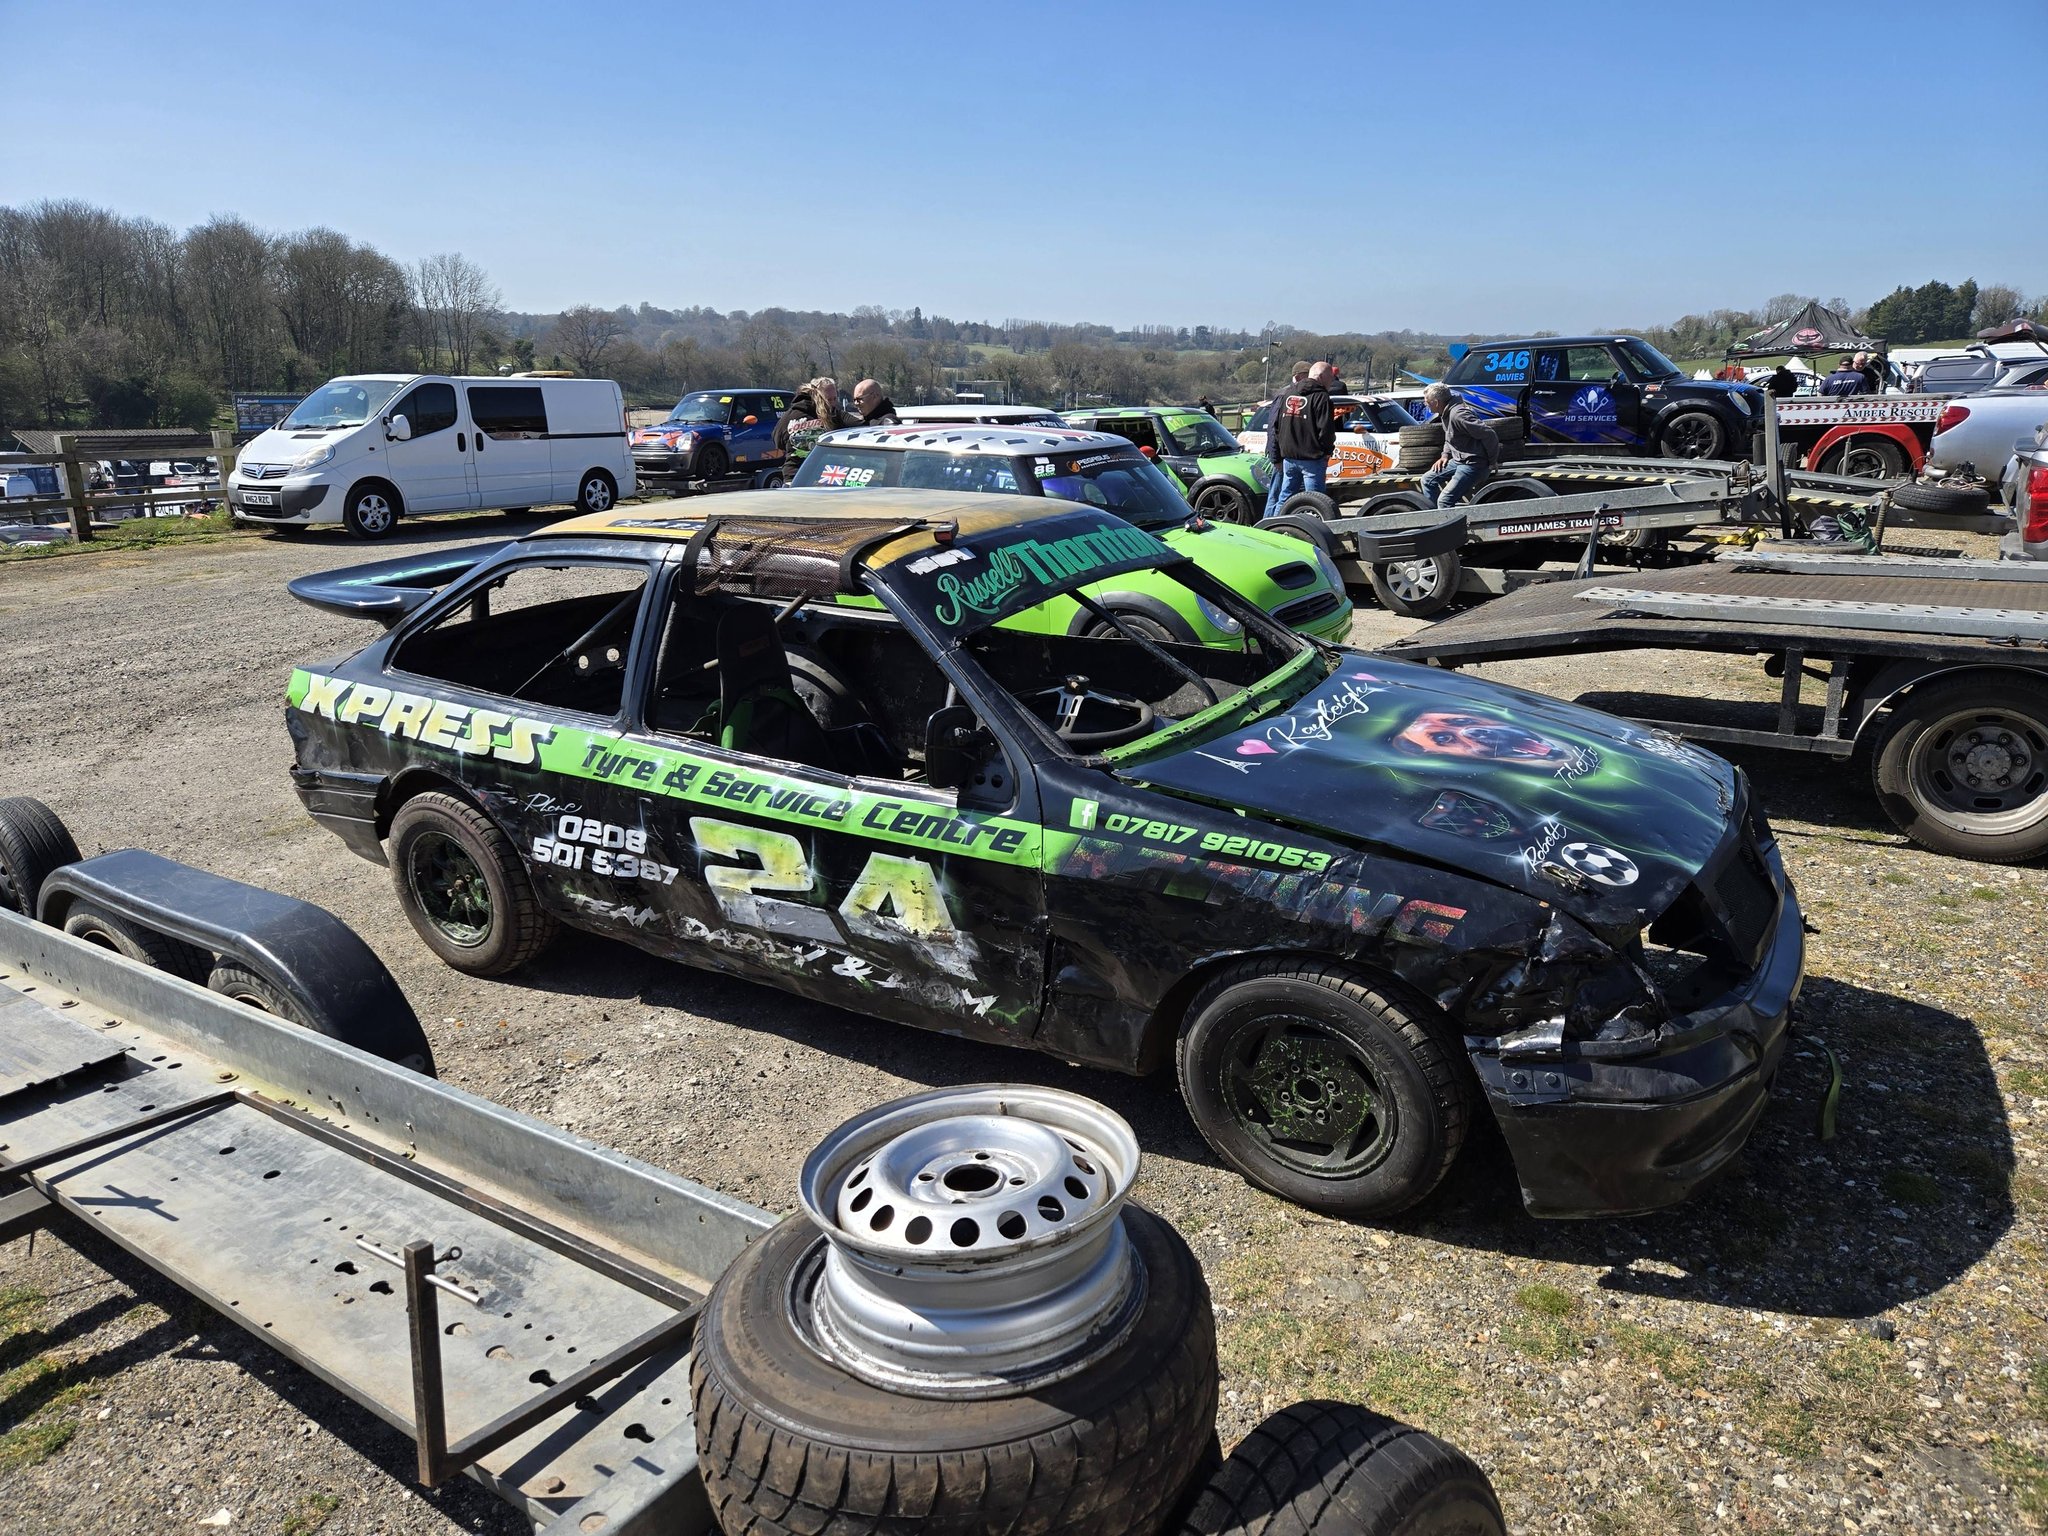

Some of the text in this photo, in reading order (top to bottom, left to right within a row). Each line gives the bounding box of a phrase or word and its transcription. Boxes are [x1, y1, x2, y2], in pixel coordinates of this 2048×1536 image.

[1484, 351, 1530, 372] 346
[1495, 373, 1525, 382] DAVIES
[771, 396, 785, 409] 25
[1843, 407, 1938, 418] AMBER RESCUE
[1331, 448, 1383, 467] RESCUE
[846, 467, 875, 482] 86
[1034, 464, 1055, 474] 86
[1501, 516, 1620, 534] BRIAN JAMES TRAIERS
[935, 525, 1167, 625] Russell Thornton
[300, 673, 1028, 854] XPRESS Tyre & Service Centre
[524, 792, 582, 814] Phone
[558, 815, 647, 855] 0208
[1104, 813, 1198, 844] 07817
[1200, 832, 1332, 872] 921053
[532, 836, 680, 886] 501 5387
